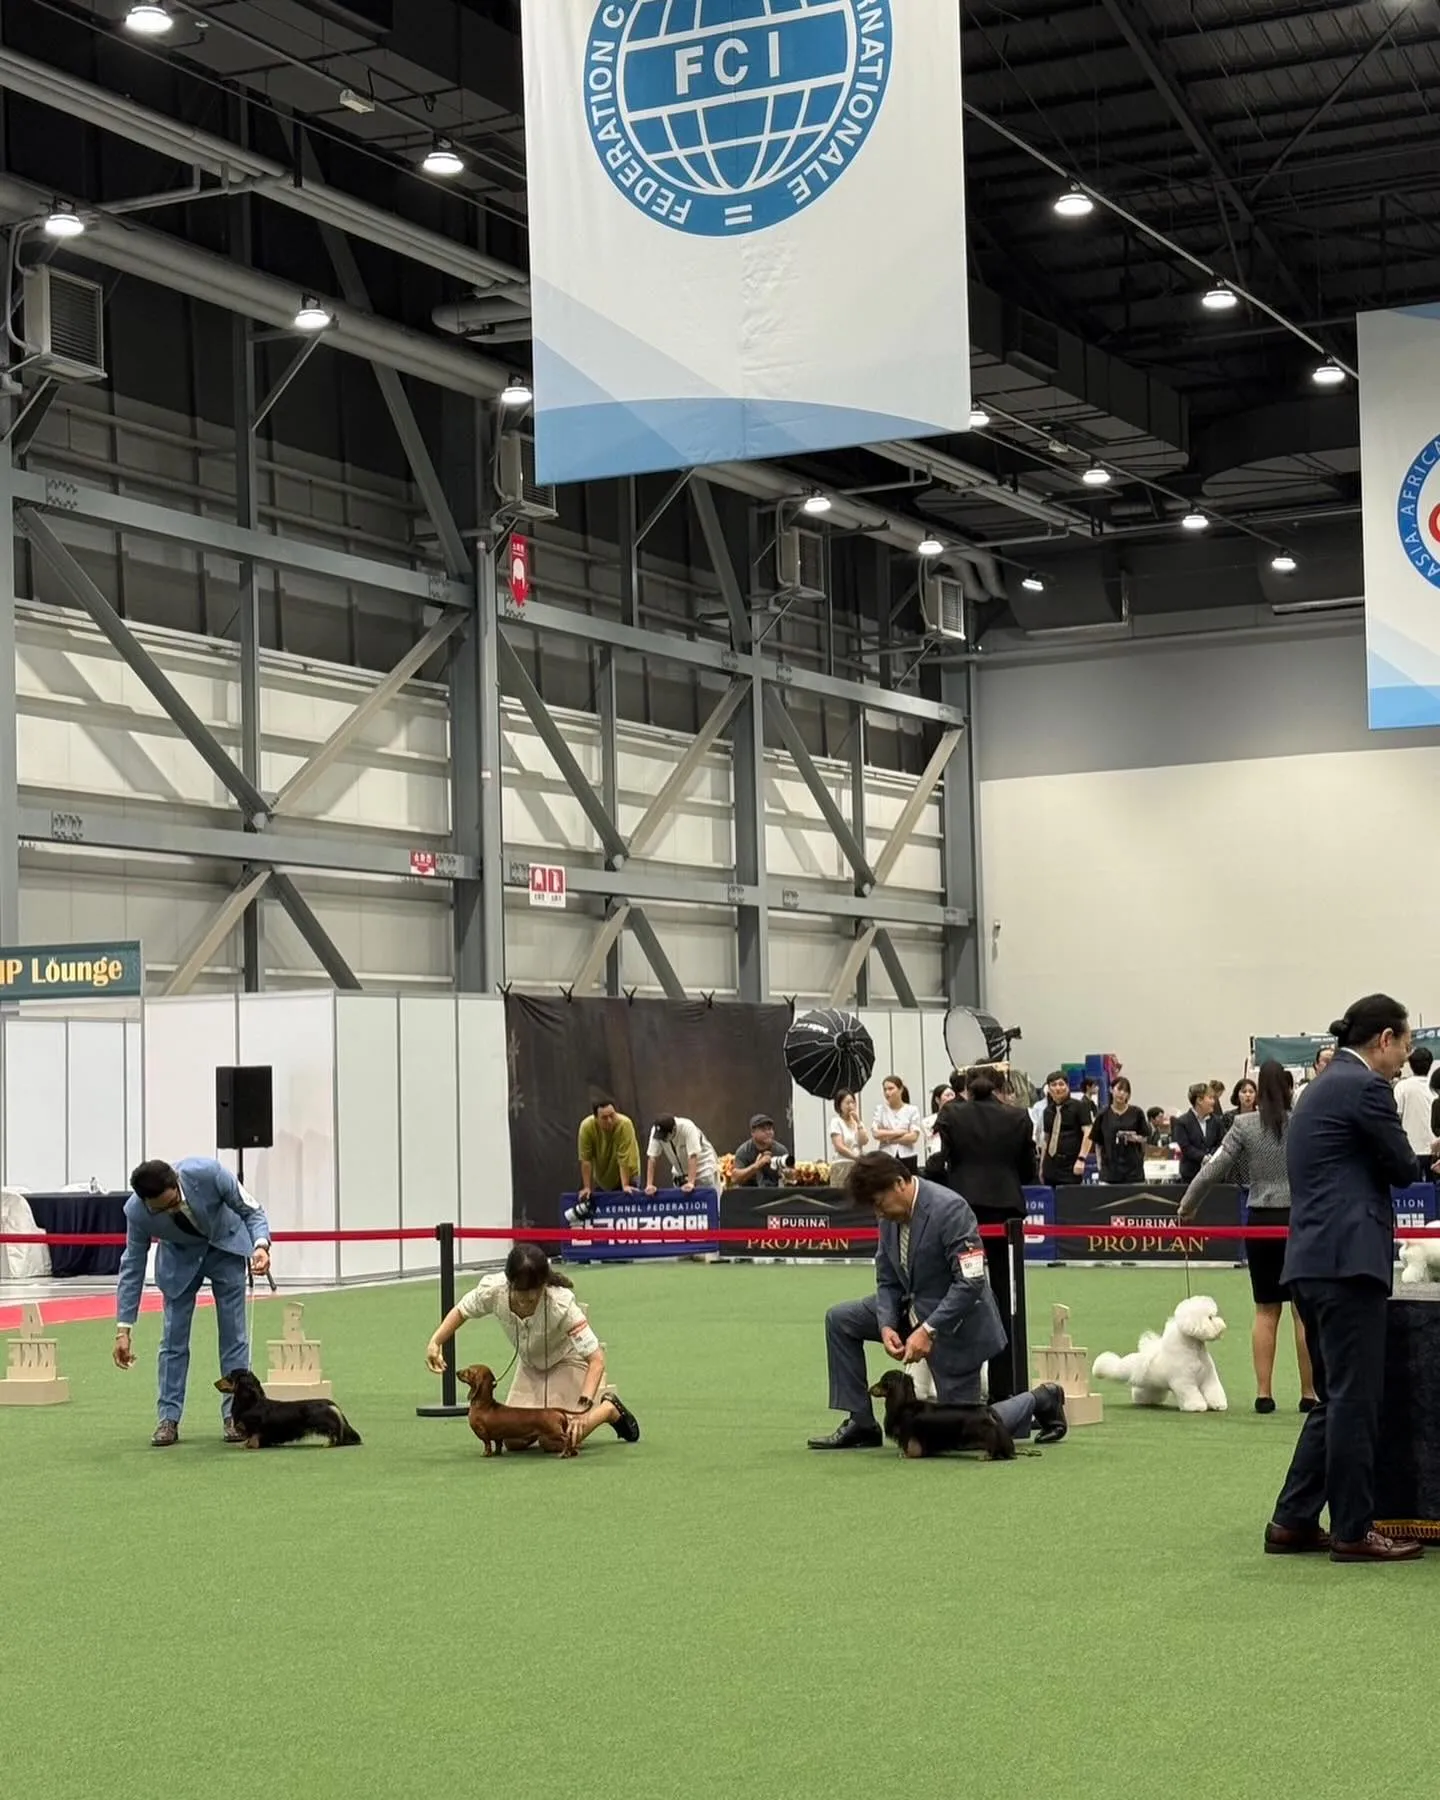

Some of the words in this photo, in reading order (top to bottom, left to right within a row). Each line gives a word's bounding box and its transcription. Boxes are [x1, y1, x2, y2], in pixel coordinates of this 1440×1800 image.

[675, 31, 781, 96] FCI
[588, 40, 693, 225] FEDERATION
[31, 956, 123, 987] Lounge
[605, 1203, 643, 1214] KENNEL
[647, 1201, 708, 1213] FEDERATION
[782, 1217, 826, 1228] PURINA
[1127, 1218, 1175, 1228] PURINA
[746, 1237, 790, 1250] PRO
[793, 1237, 850, 1251] PLAN
[1087, 1235, 1137, 1252] PRO
[1142, 1236, 1204, 1253] PLAN
